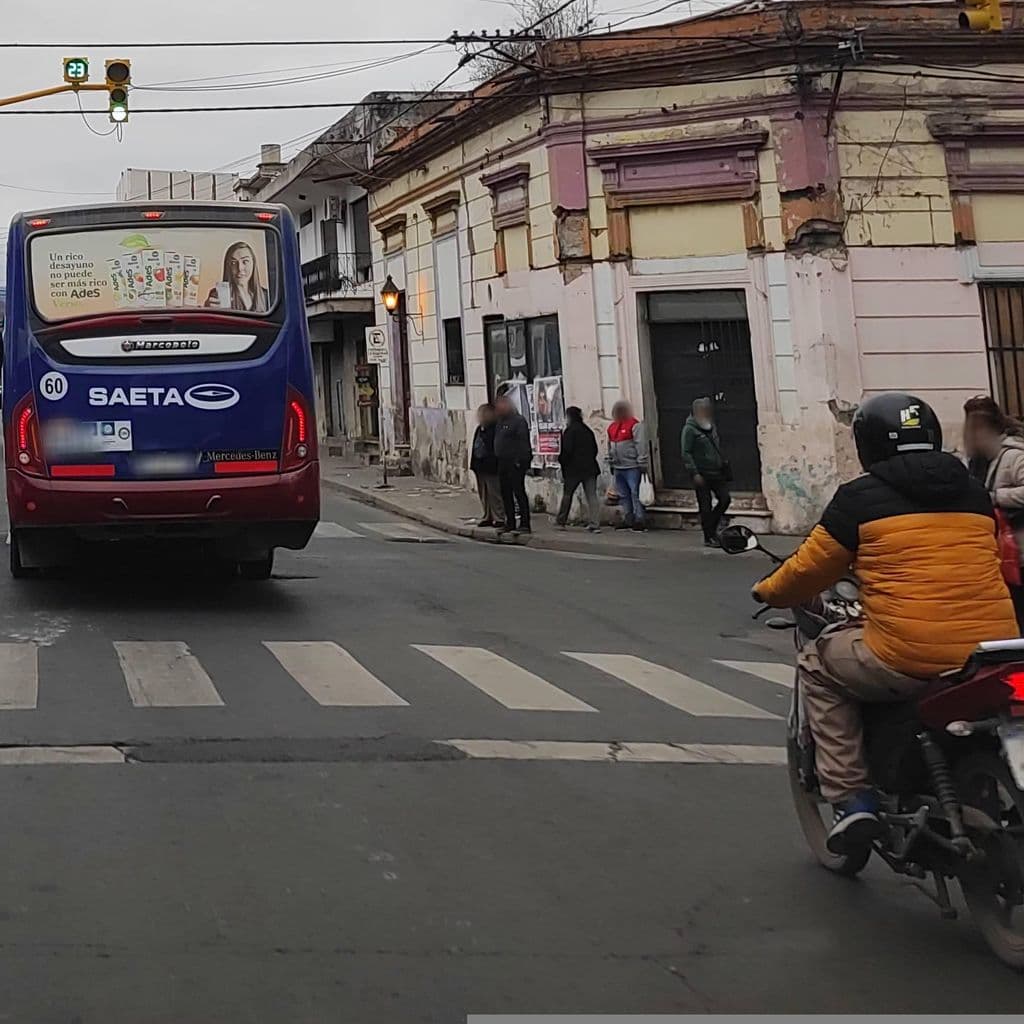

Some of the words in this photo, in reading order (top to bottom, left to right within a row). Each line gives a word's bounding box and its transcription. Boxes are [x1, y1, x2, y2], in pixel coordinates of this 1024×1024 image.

[68, 62, 85, 77] 23
[49, 252, 63, 261] Un
[65, 252, 83, 261] rico
[49, 262, 94, 270] desayuno
[64, 270, 93, 279] puede
[68, 279, 87, 287] más
[89, 279, 107, 287] rico
[70, 288, 101, 299] AdeS
[136, 340, 199, 350] Marcopolo
[45, 377, 63, 394] 60
[89, 388, 184, 406] SAETA
[206, 450, 277, 461] Mercedes-Benz
